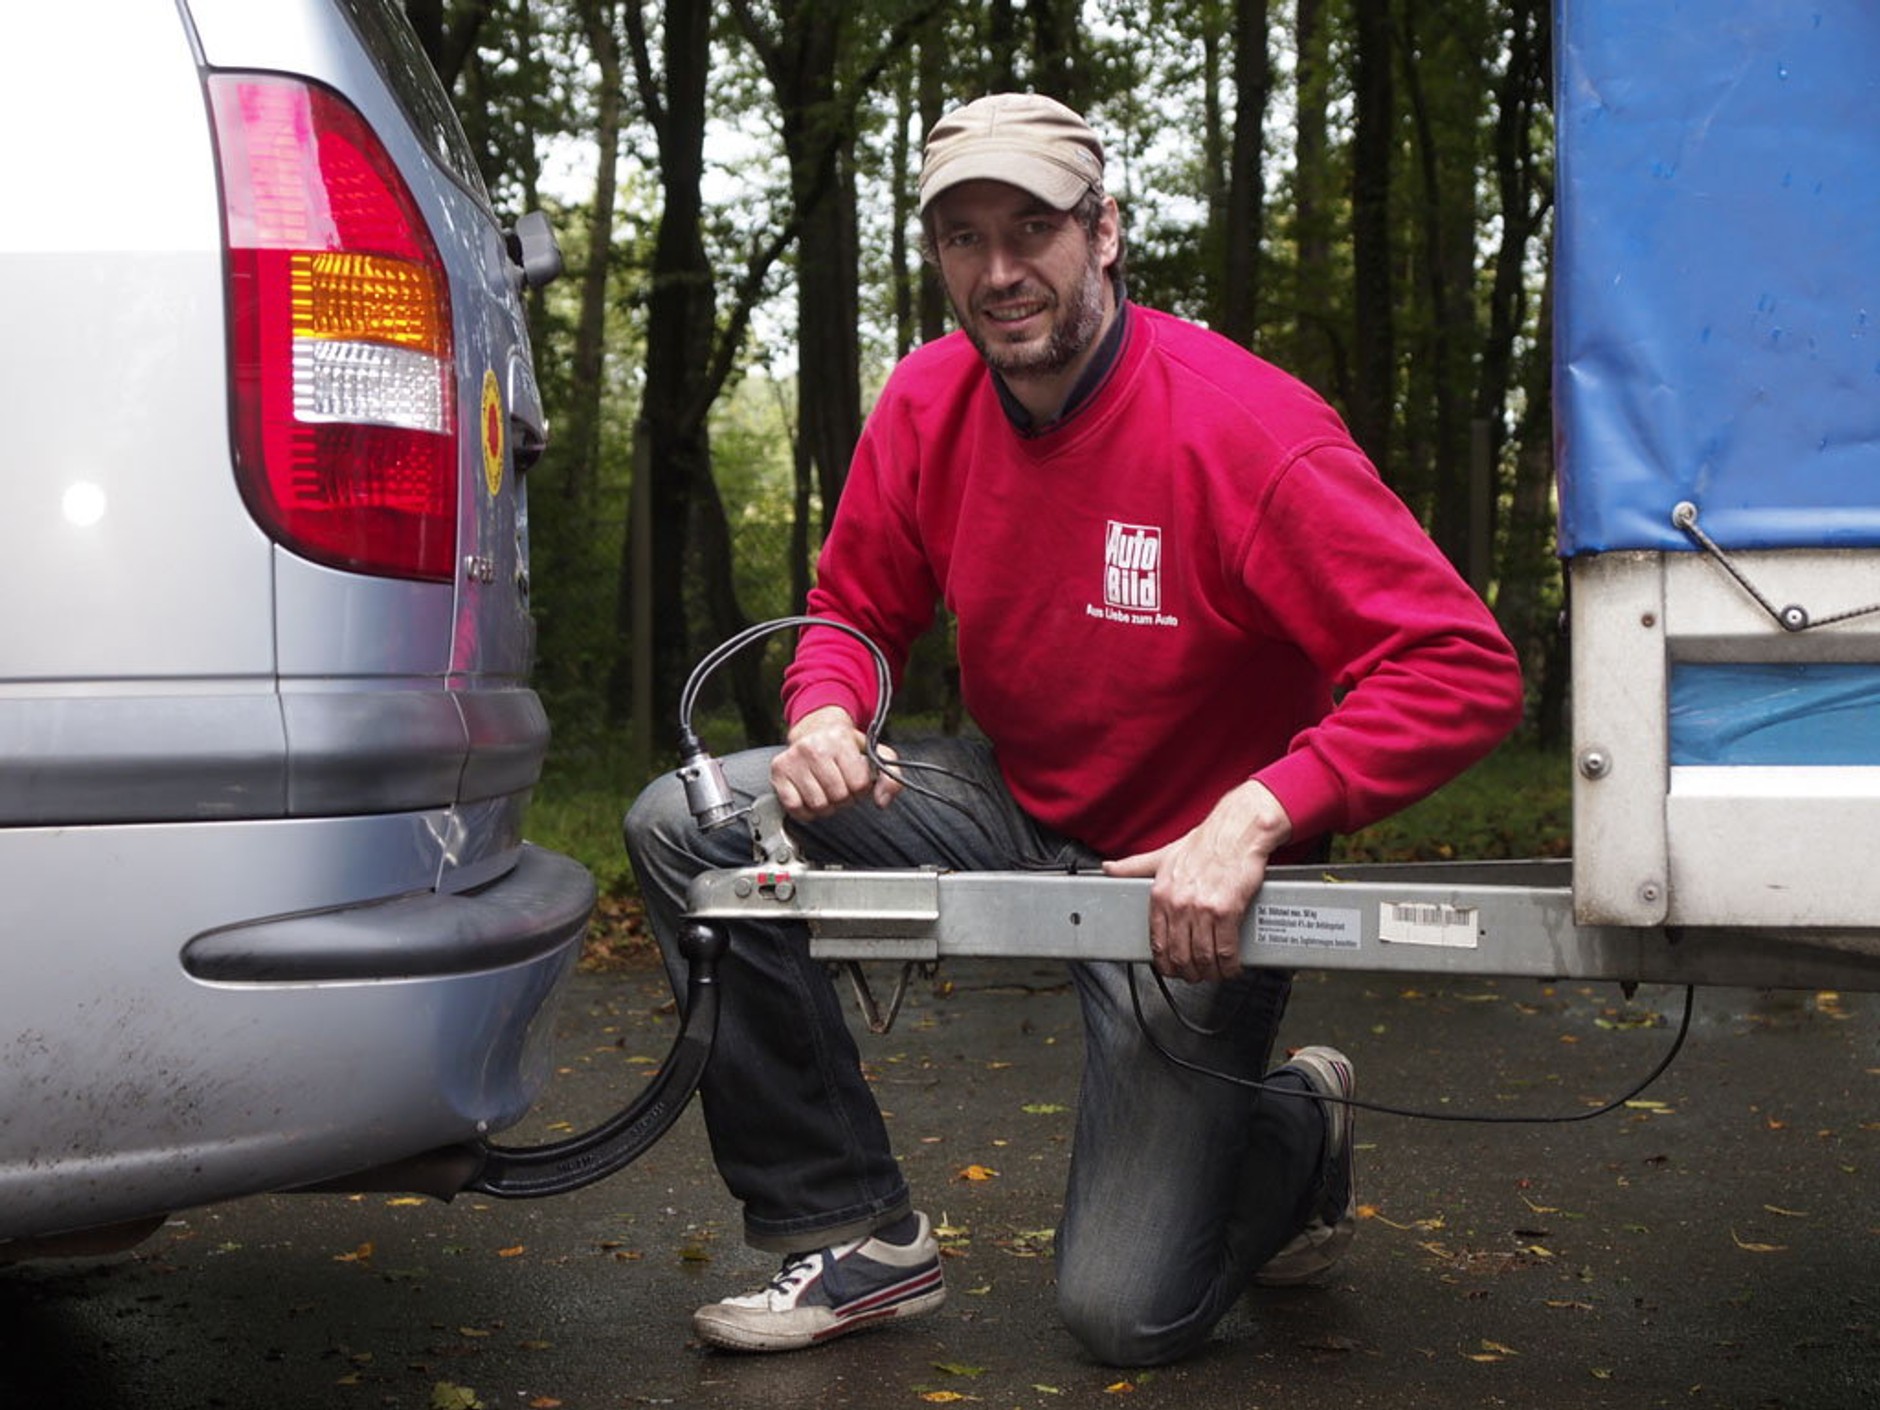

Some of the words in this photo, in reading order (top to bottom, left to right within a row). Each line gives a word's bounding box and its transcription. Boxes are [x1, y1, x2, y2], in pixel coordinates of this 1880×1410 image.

[1107, 523, 1158, 571] Auto
[1107, 565, 1156, 607] Bild
[1086, 603, 1104, 618] Aus
[1105, 606, 1130, 623] Liebe
[1131, 614, 1153, 625] zum
[1154, 613, 1178, 627] Auto
